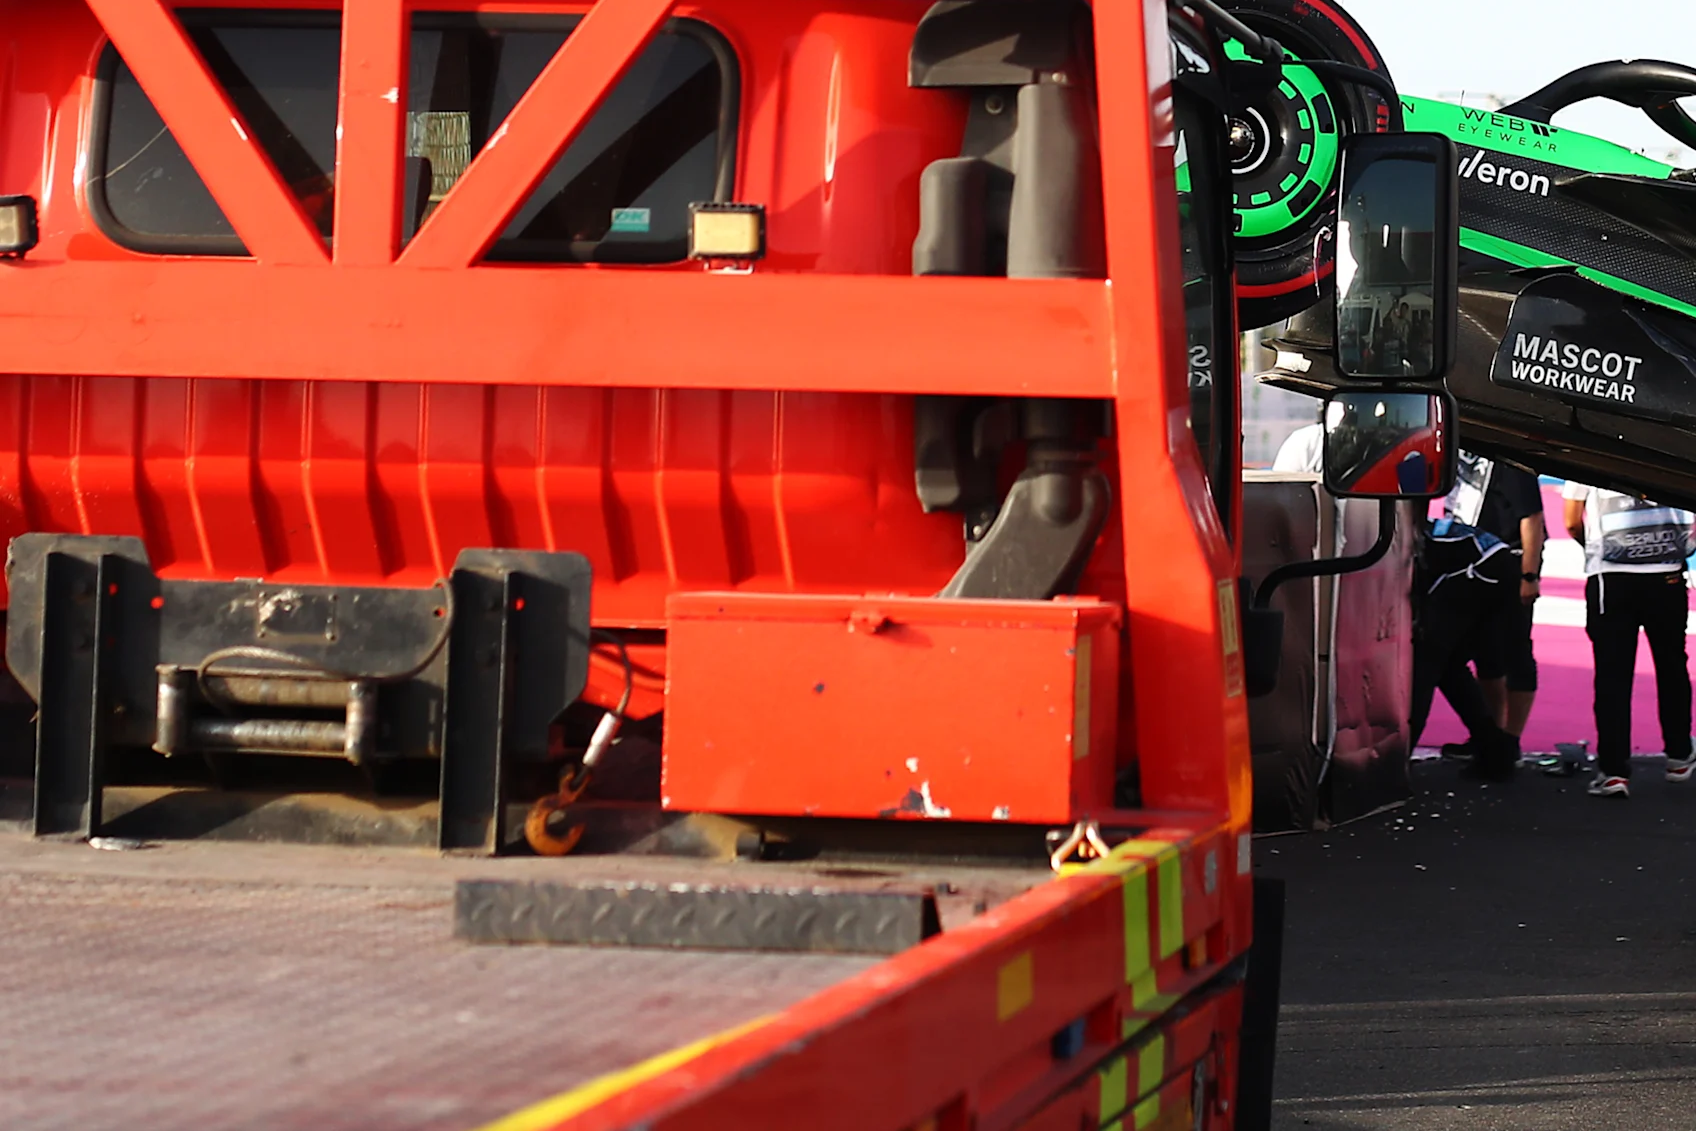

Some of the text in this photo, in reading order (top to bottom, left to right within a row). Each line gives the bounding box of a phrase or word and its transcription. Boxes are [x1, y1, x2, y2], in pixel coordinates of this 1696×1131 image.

[1458, 123, 1557, 152] EYEWEAR
[1460, 107, 1525, 132] WEB
[1513, 332, 1643, 381] MASCOT
[1511, 359, 1636, 404] WORKWEAR
